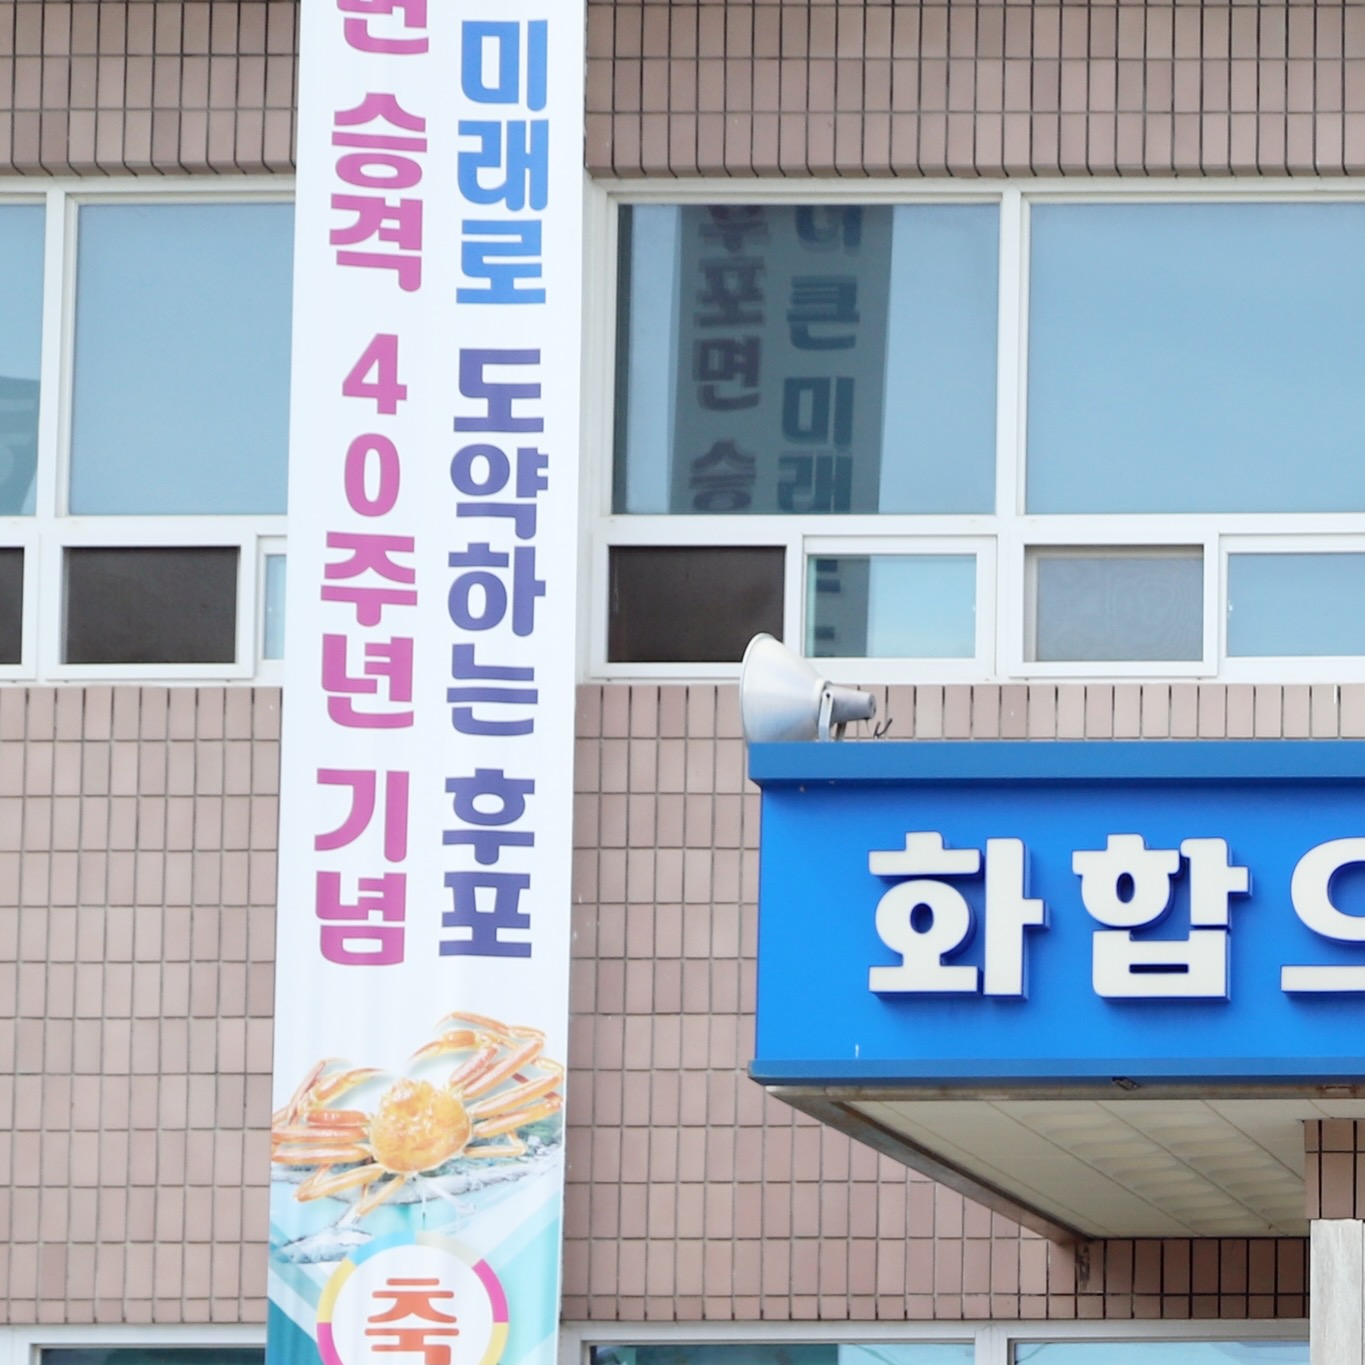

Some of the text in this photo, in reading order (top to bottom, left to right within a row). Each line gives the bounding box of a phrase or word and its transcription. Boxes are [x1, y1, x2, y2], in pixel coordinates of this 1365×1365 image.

[329, 92, 429, 293] 승격
[320, 333, 418, 730] 40주년
[439, 19, 549, 959] 미래로 도약하는 후포
[314, 768, 410, 967] 기념
